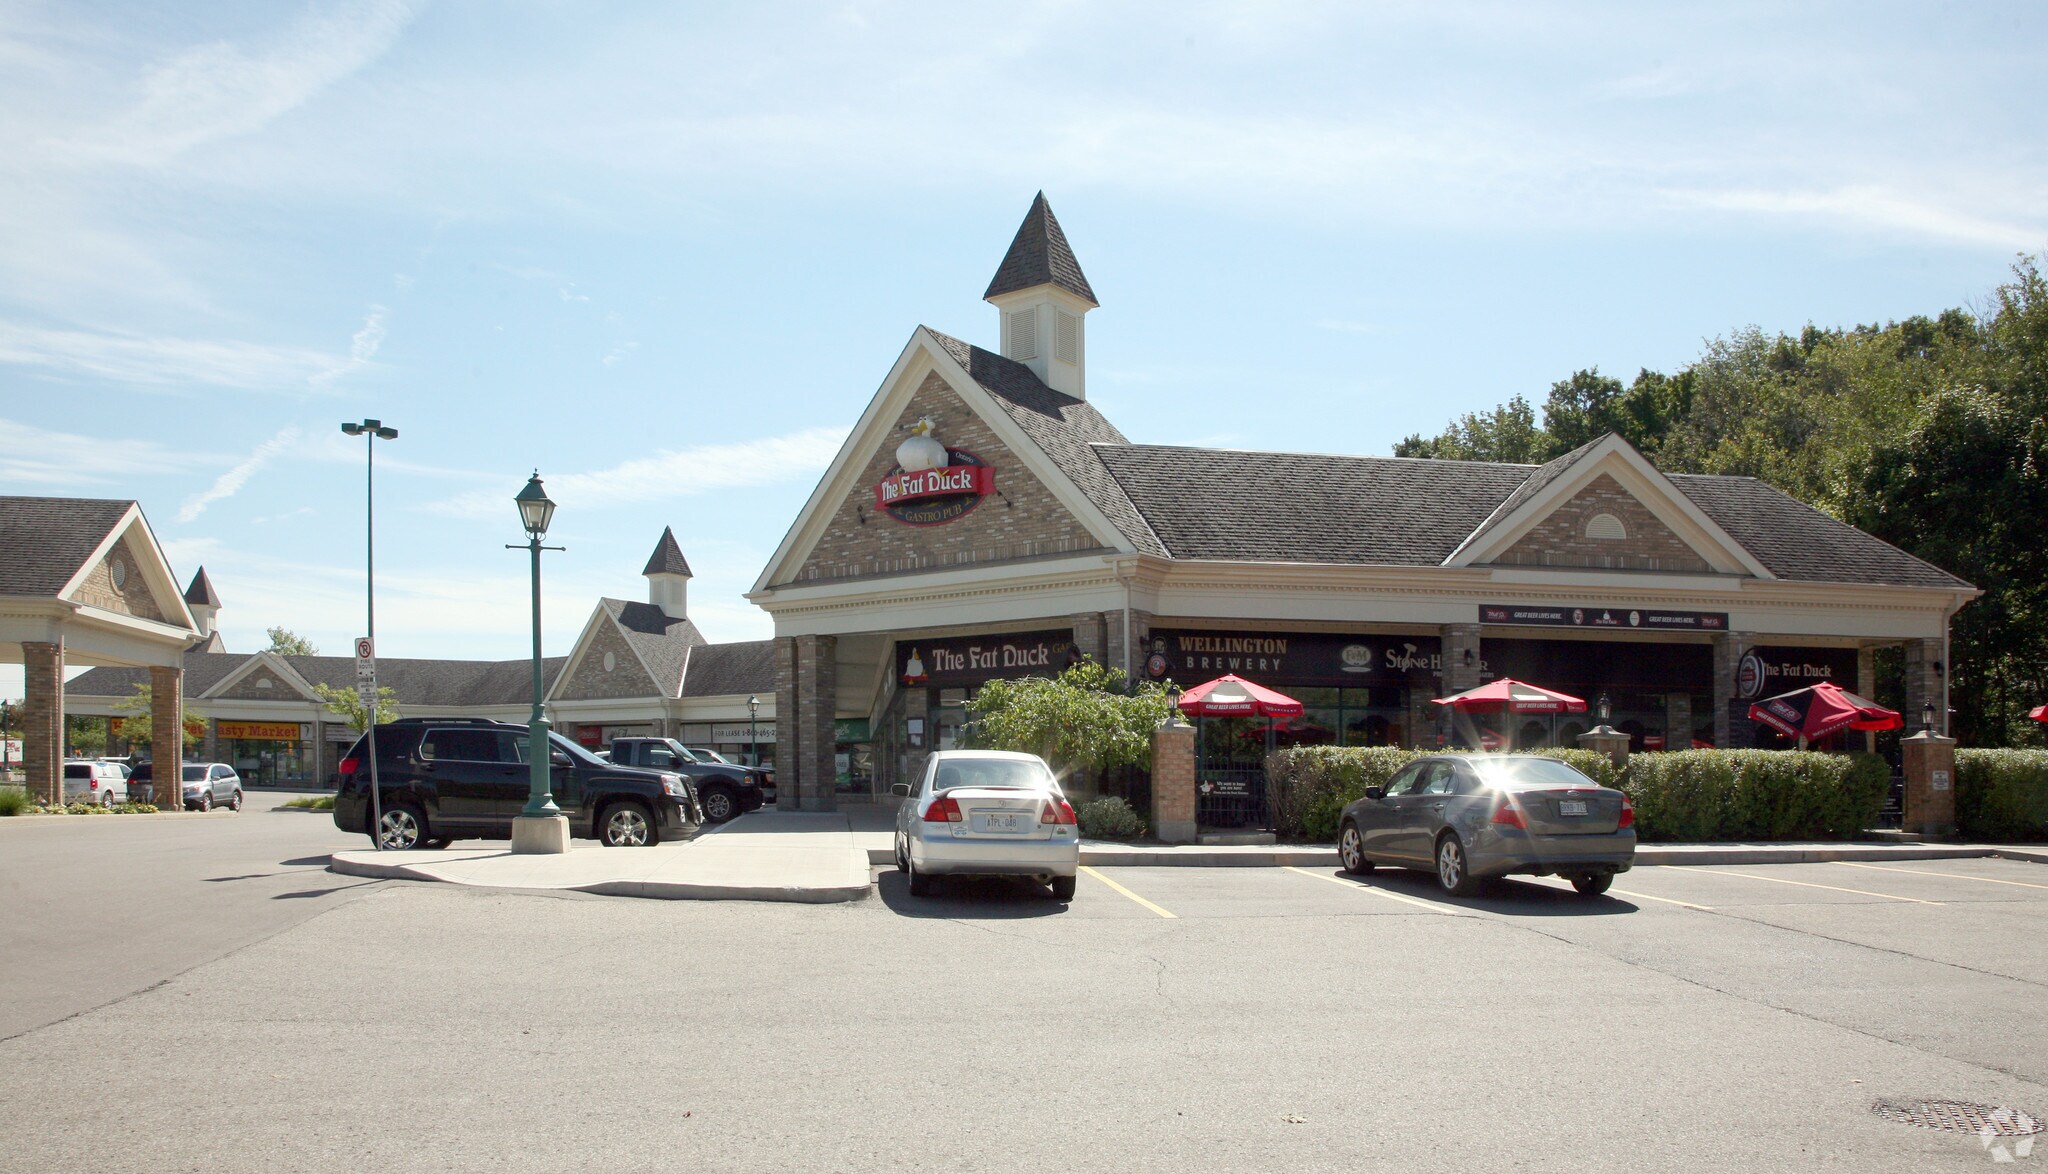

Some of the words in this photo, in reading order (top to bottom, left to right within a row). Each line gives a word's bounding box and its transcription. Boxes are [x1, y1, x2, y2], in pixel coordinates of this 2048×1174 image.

[955, 451, 974, 464] Ontario
[881, 481, 898, 502] The
[900, 475, 924, 496] Fat
[927, 469, 973, 493] Duck
[905, 511, 941, 523] GASTRO
[943, 504, 962, 519] PUB
[1178, 636, 1287, 654] WELLINGTON
[933, 648, 965, 672] The
[969, 645, 998, 670] Fat
[1002, 642, 1050, 668] Duck
[1186, 656, 1281, 670] BREWERY
[1782, 663, 1801, 677] Fat
[1803, 663, 1832, 678] Duck
[248, 725, 297, 738] Market
[725, 729, 741, 737] LEASE
